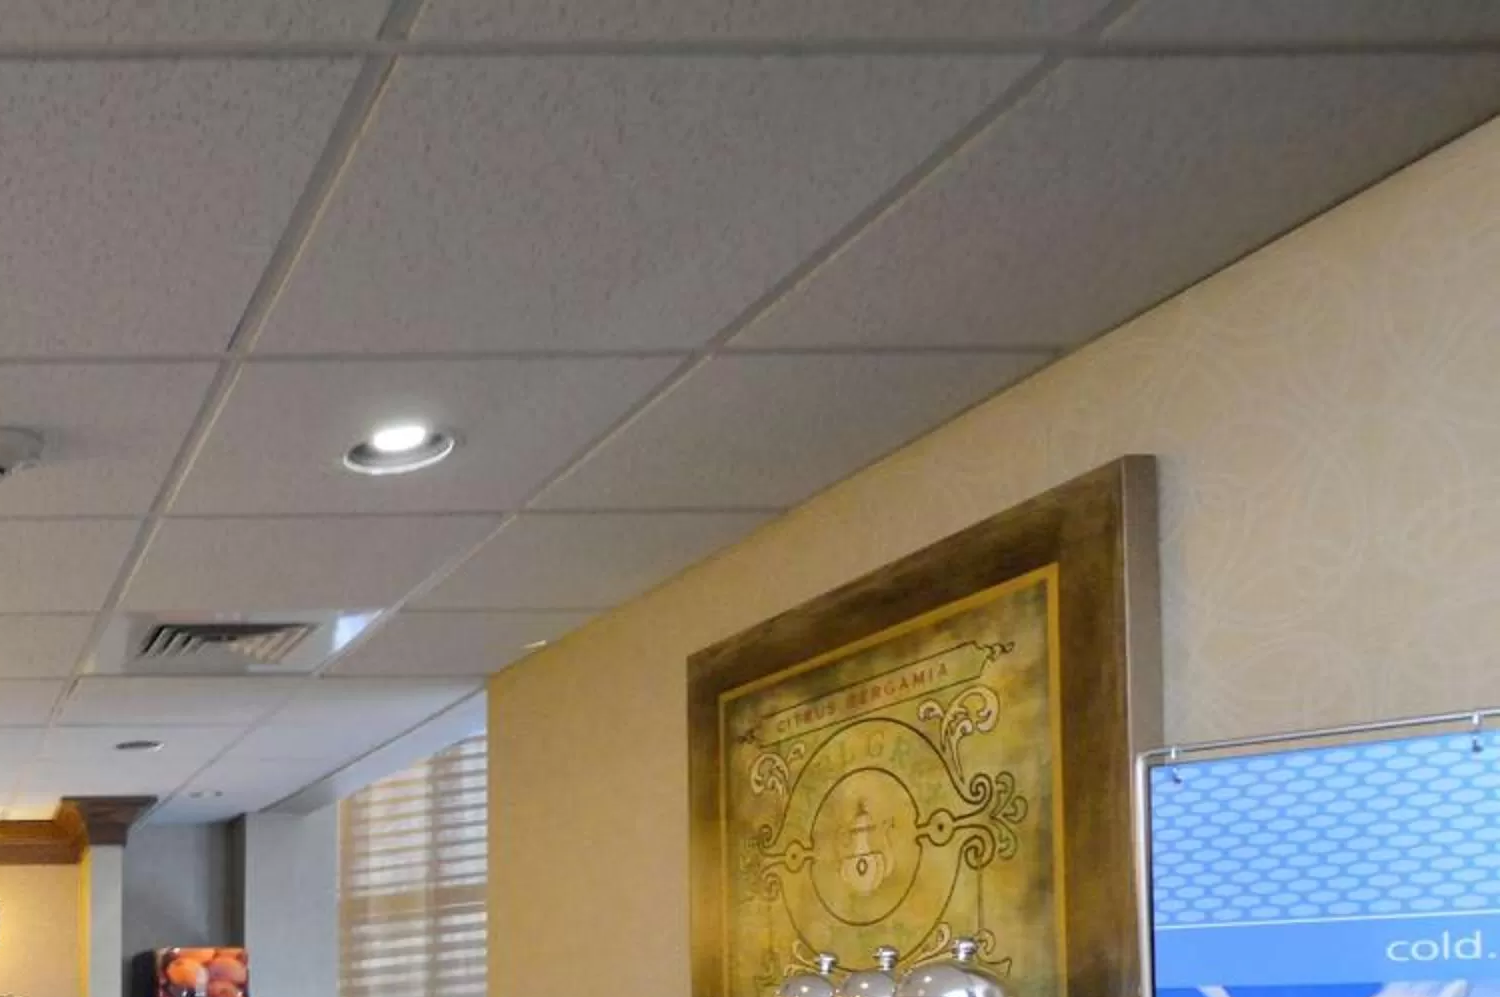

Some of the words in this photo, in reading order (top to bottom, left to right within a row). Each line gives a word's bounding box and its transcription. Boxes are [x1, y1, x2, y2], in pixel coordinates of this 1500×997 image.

[776, 701, 837, 733] CITRUS
[845, 662, 948, 709] BERGAMIA
[1386, 930, 1497, 961] cold.
